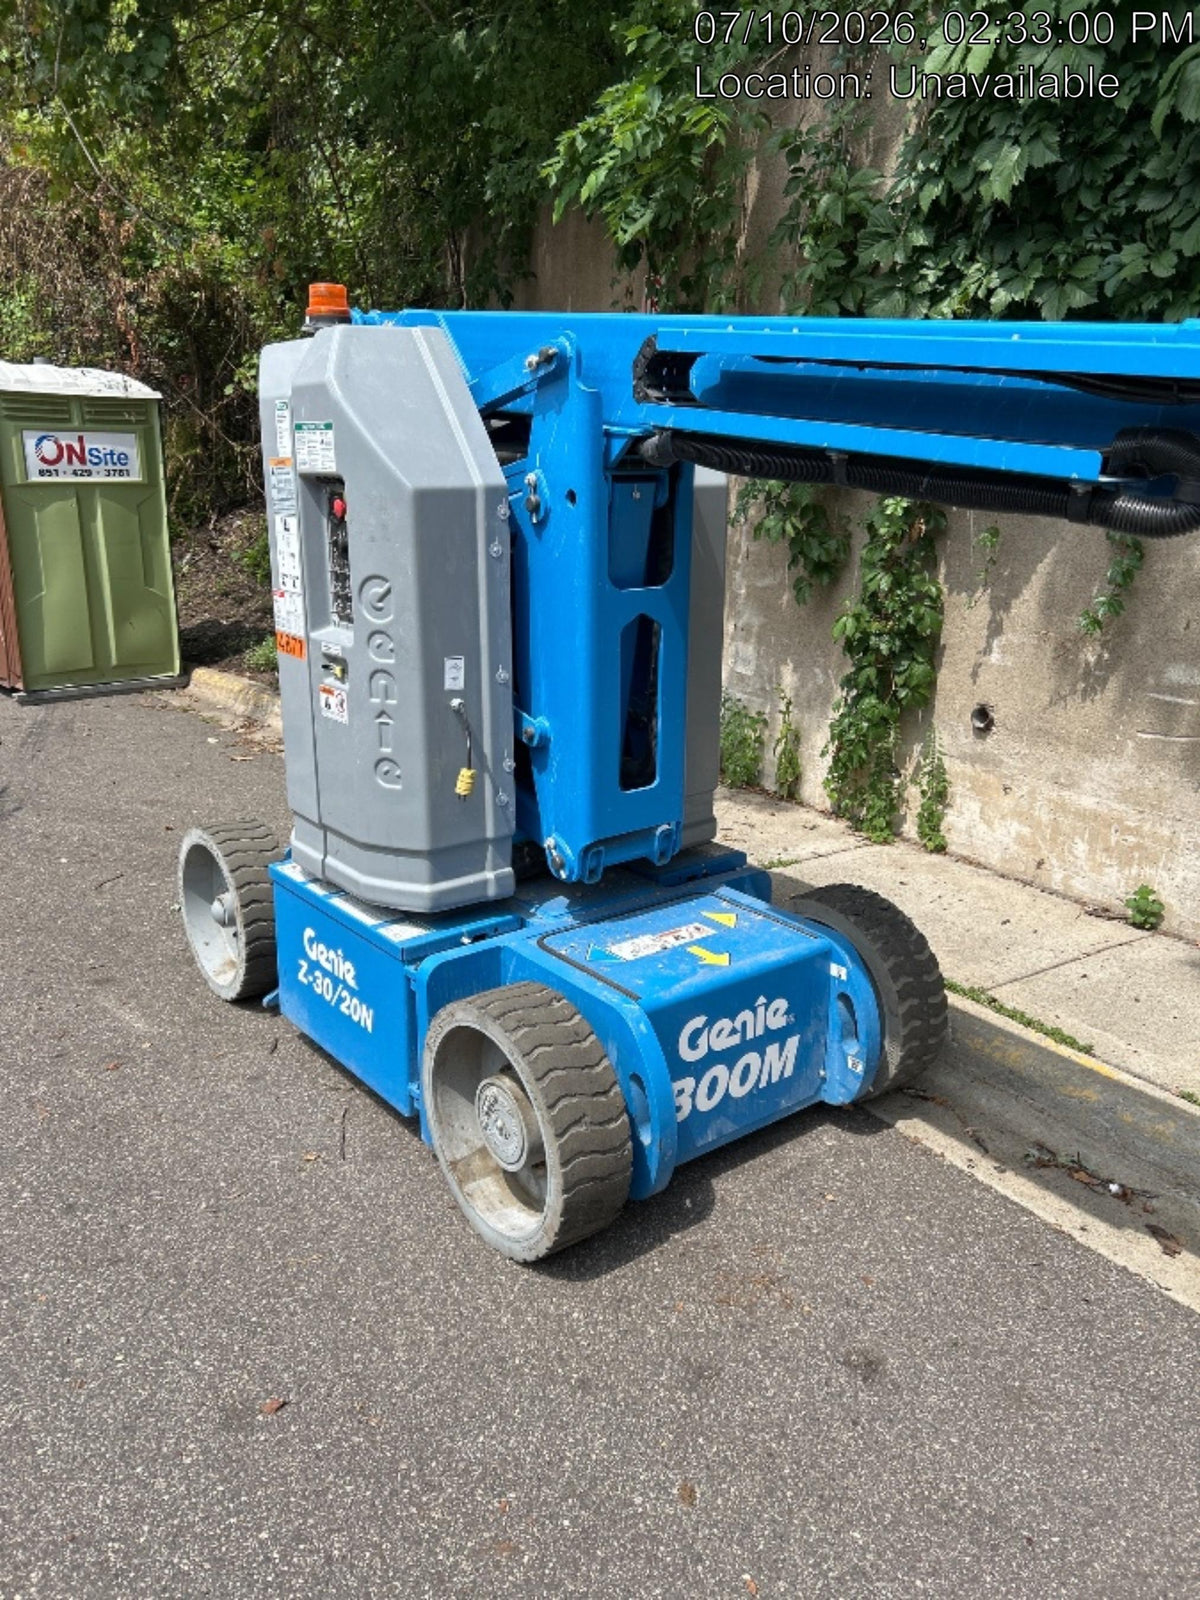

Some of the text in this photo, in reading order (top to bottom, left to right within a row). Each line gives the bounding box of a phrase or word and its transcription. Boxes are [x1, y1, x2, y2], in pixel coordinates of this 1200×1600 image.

[71, 468, 93, 477] 429
[303, 927, 359, 990] Genie
[297, 959, 374, 1033] Z-30/20N
[678, 995, 789, 1062] Genie
